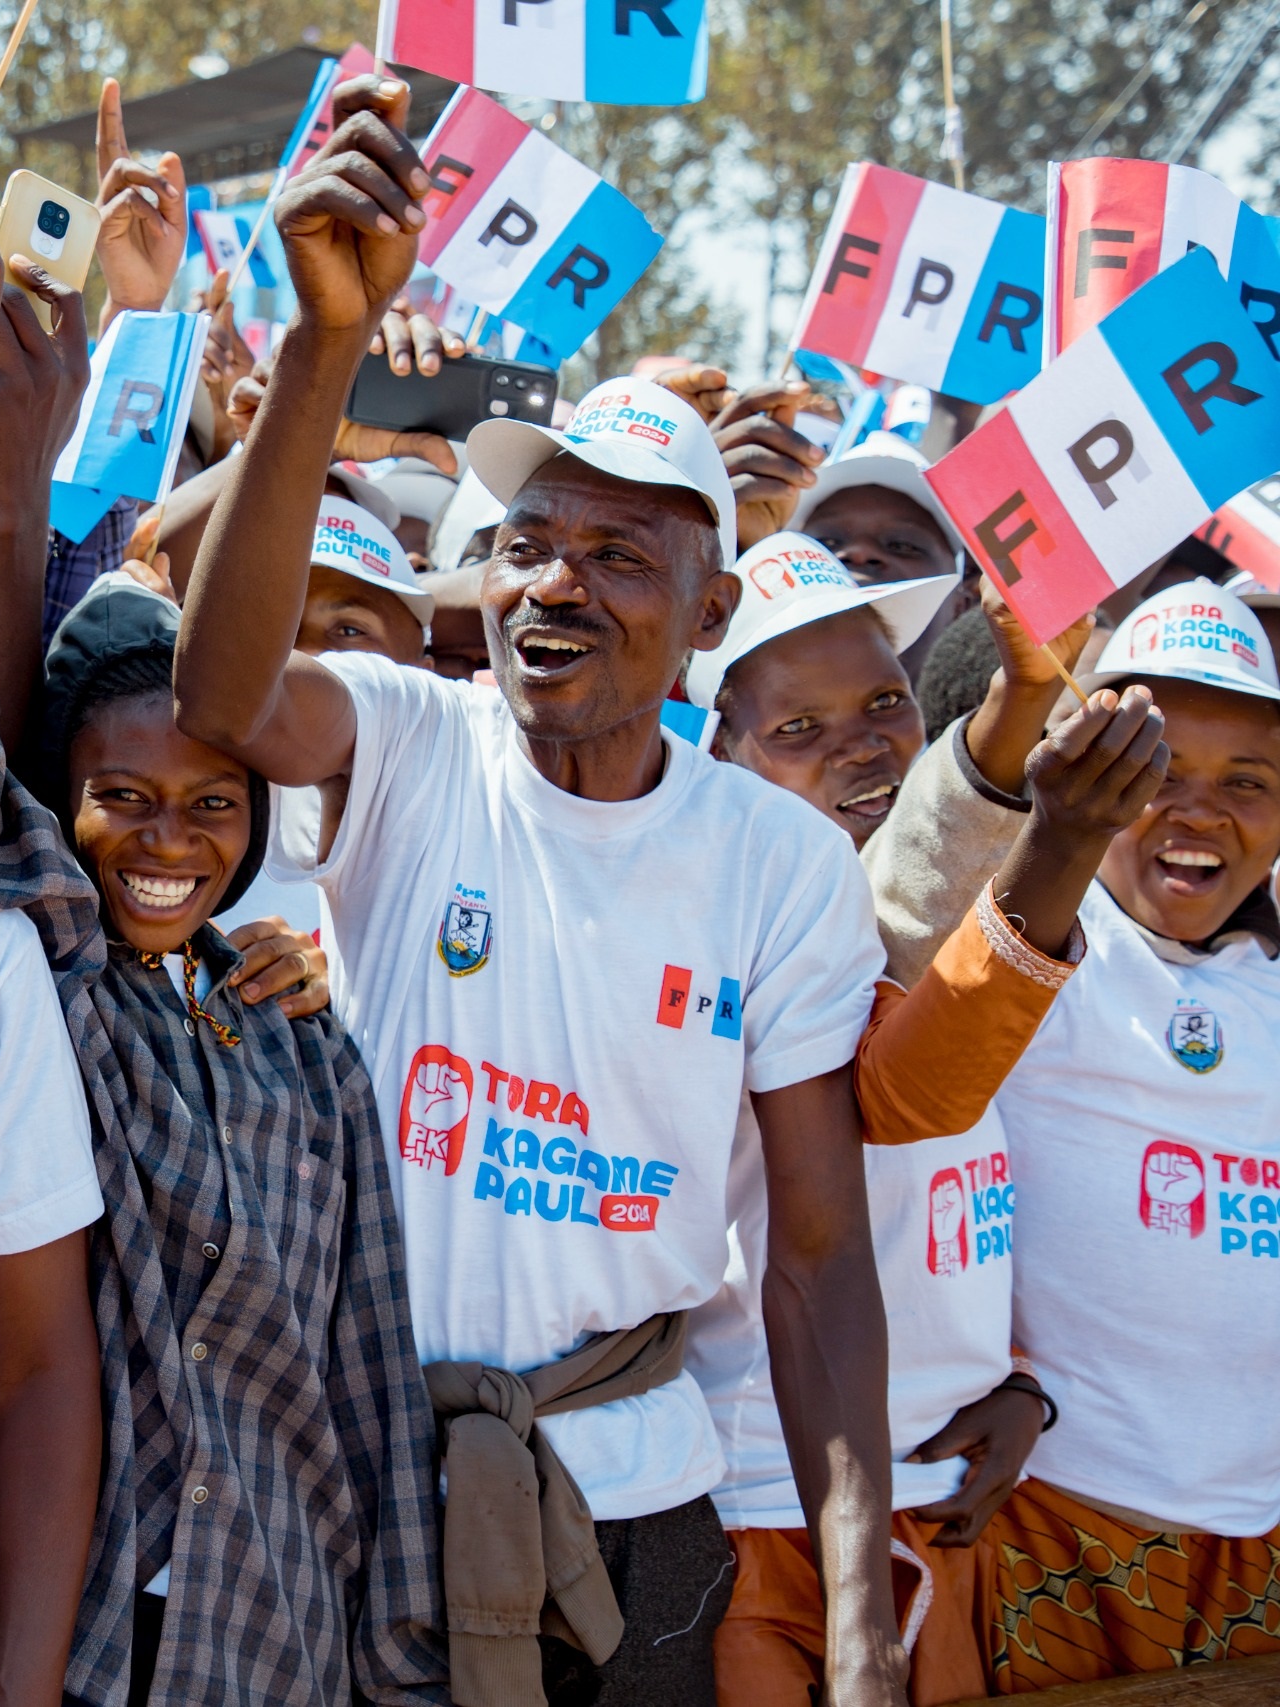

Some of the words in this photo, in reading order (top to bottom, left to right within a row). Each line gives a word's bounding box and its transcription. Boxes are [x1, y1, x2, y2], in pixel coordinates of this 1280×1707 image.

[822, 232, 1042, 353] FPR
[631, 427, 666, 443] 2024
[974, 341, 1264, 588] FPR
[315, 541, 359, 560] AUL
[317, 527, 391, 563] AGAME
[1162, 635, 1228, 653] PAUL
[1163, 619, 1257, 653] KAGAME
[667, 988, 734, 1020] FPR
[474, 1161, 599, 1226] PAUL
